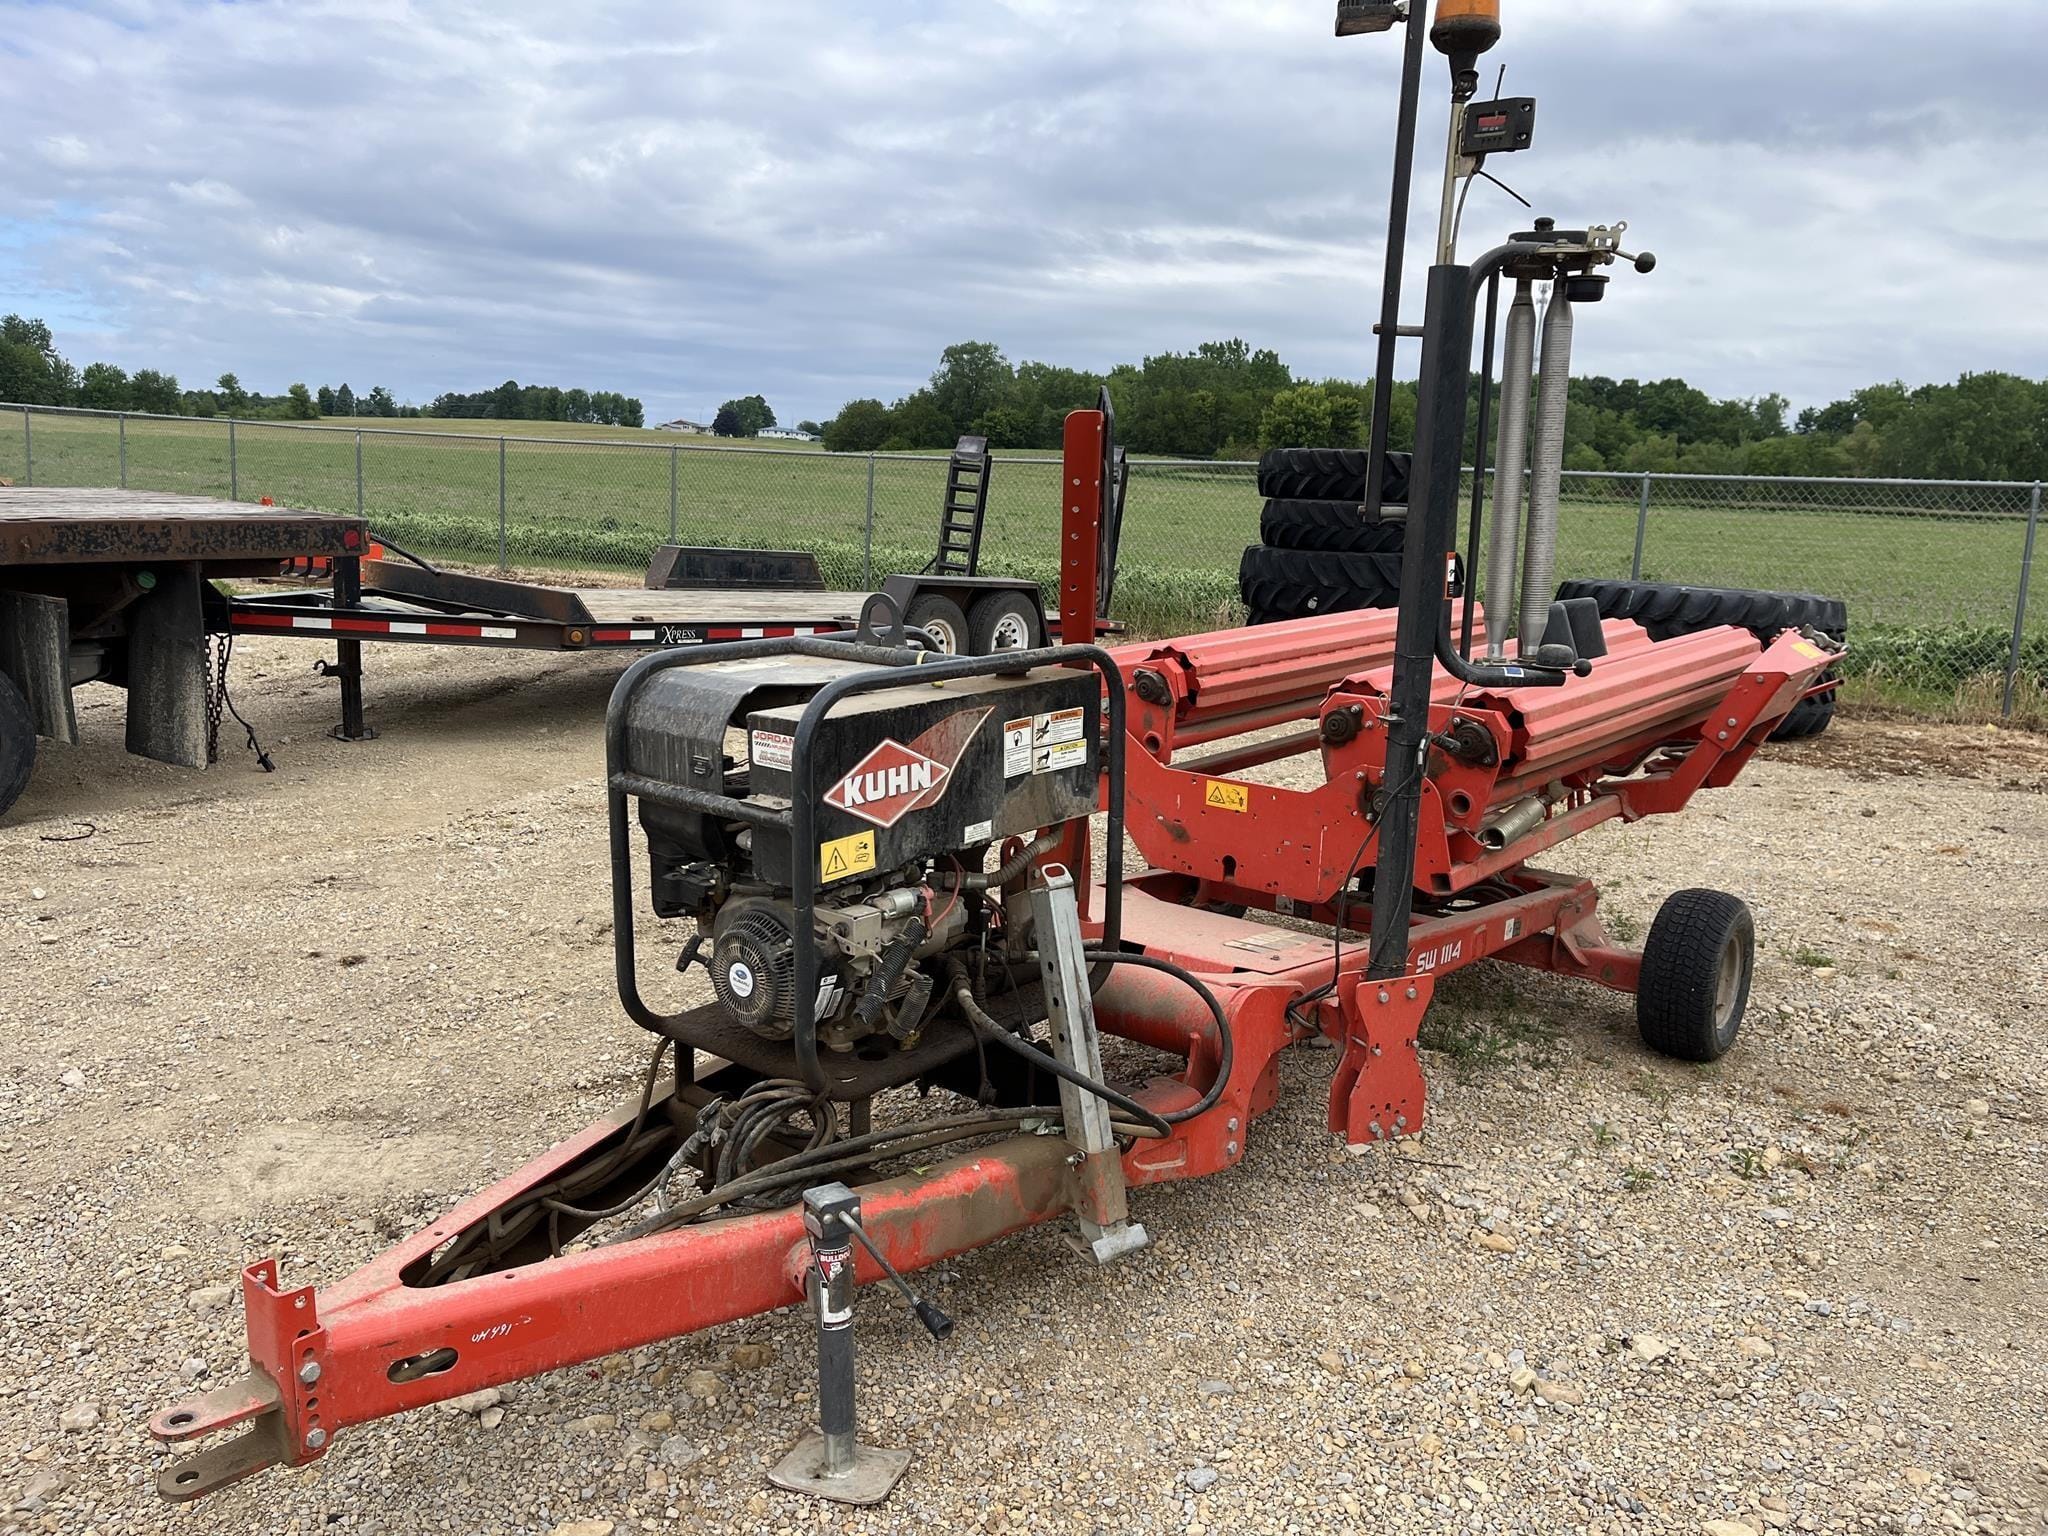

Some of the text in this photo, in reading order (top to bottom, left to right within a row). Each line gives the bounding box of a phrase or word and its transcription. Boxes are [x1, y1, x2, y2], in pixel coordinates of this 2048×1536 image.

[844, 760, 932, 808] KUHN
[1416, 940, 1462, 974] SW 1114
